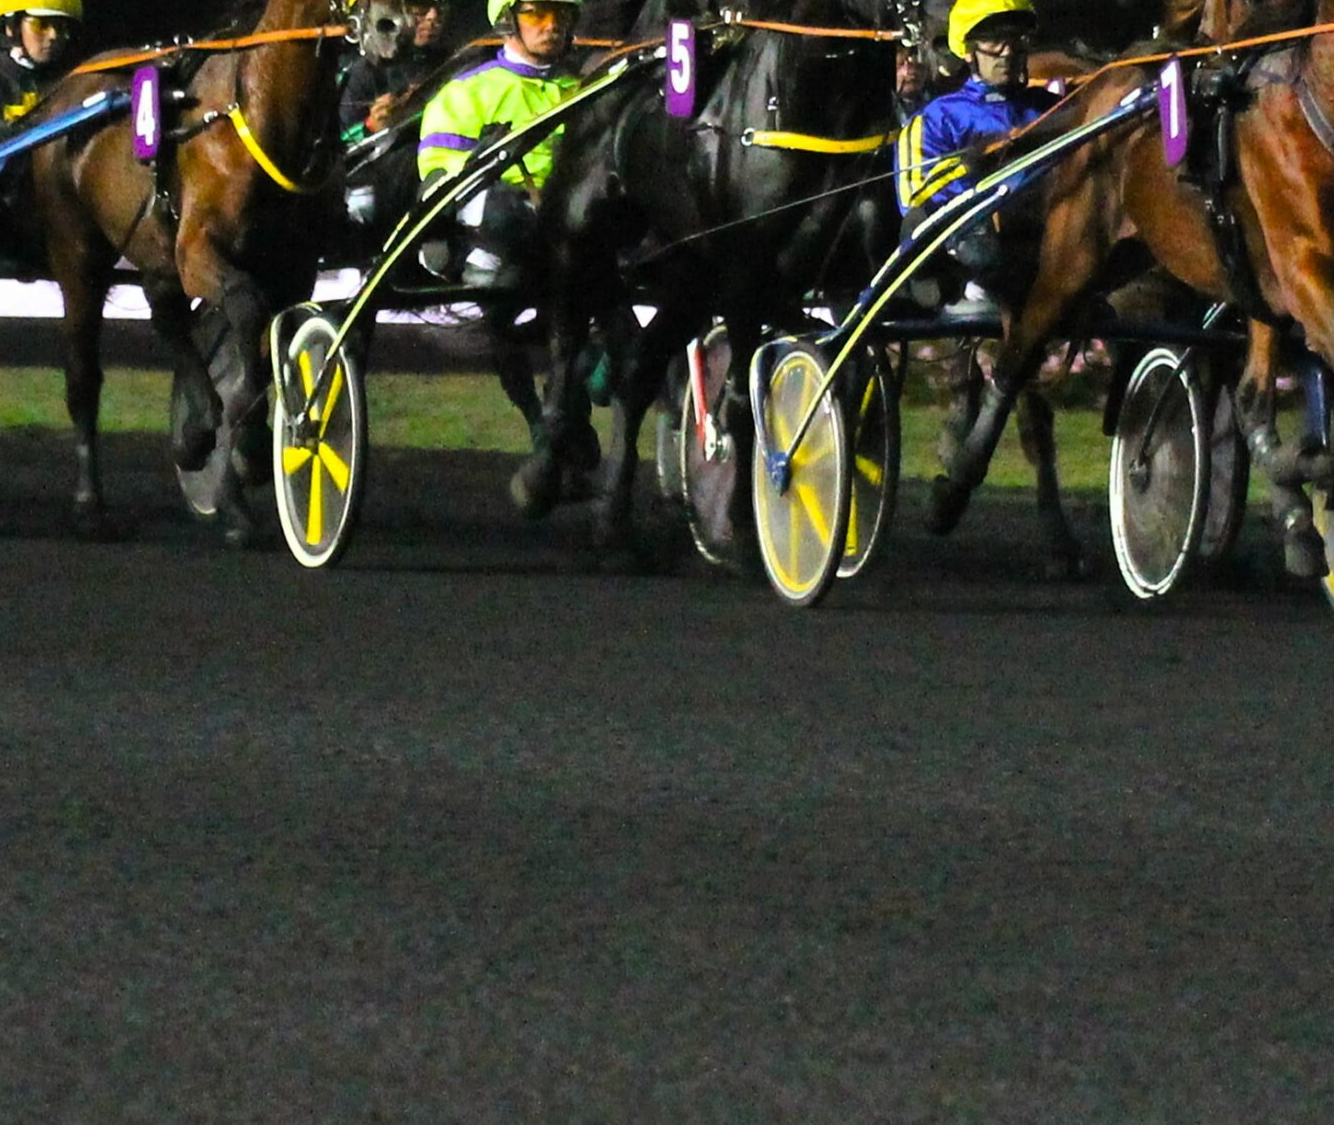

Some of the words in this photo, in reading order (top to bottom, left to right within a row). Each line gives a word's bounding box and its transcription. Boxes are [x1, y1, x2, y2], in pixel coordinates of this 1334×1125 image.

[670, 22, 691, 94] 5
[136, 79, 155, 146] 4
[1160, 60, 1179, 140] 1
